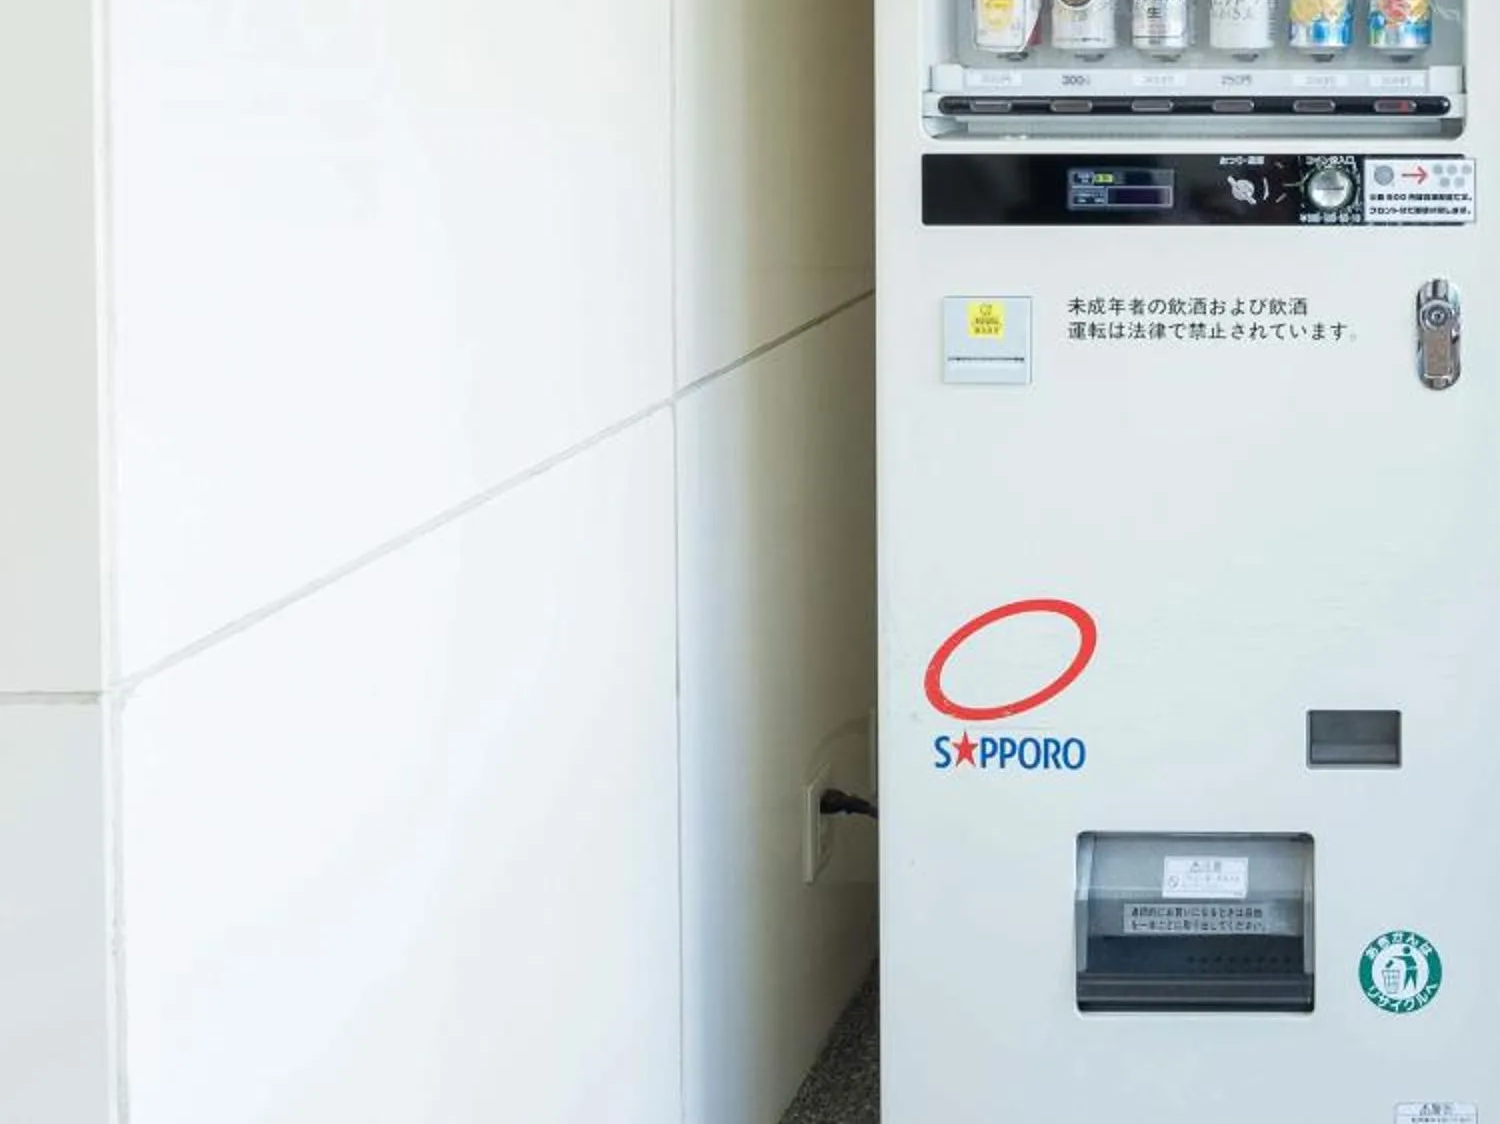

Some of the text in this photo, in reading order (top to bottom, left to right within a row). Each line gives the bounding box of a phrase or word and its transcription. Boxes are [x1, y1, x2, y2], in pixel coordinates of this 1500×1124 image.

[1067, 296, 1309, 317] 未成年者の飲酒および飲酒
[1067, 321, 1357, 342] 運転は法律で禁止されています。
